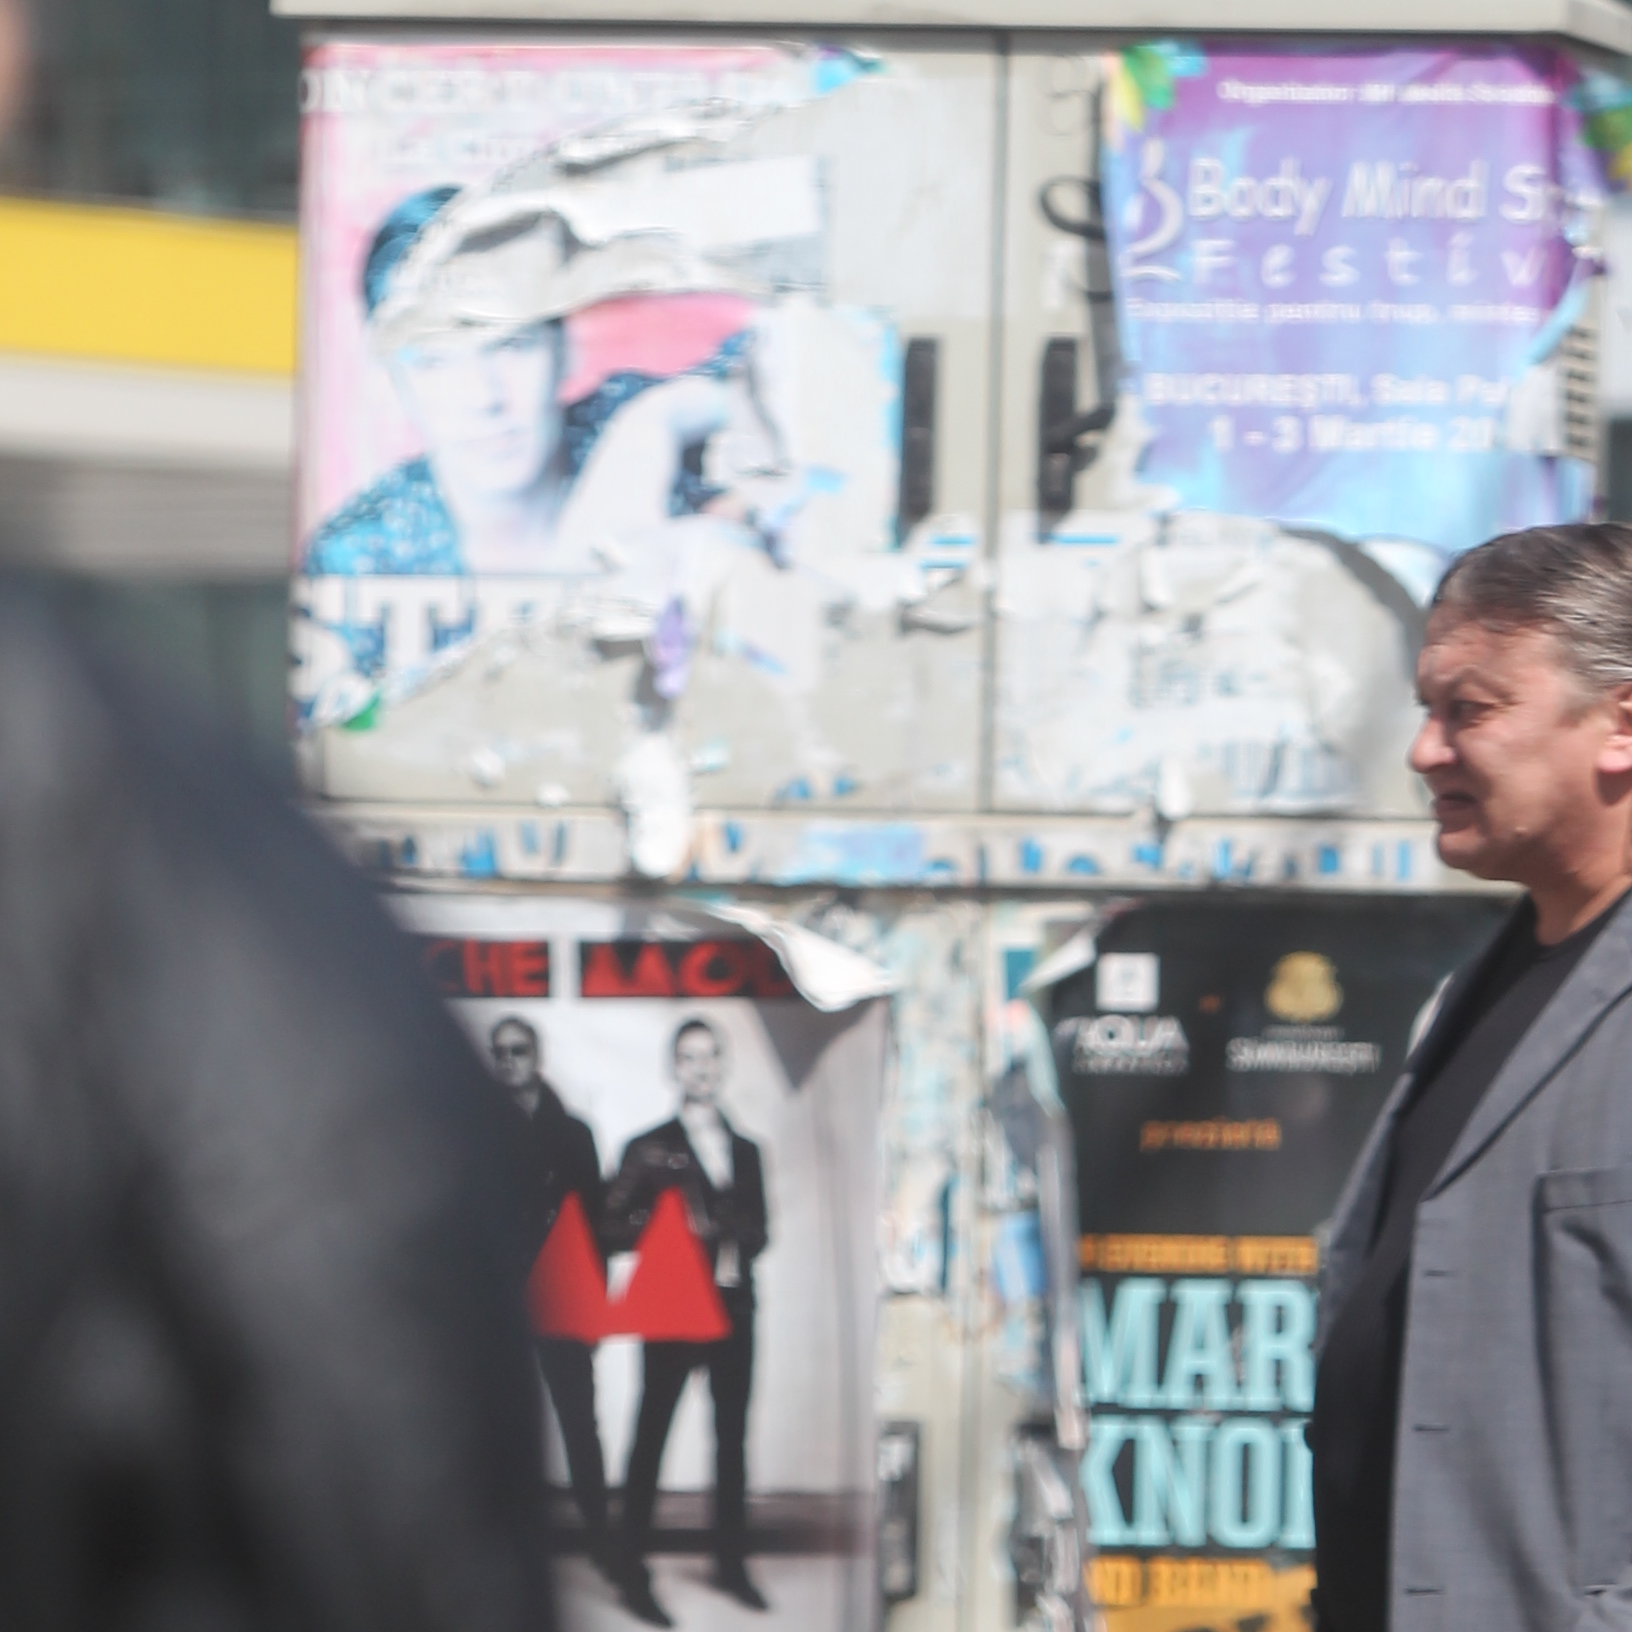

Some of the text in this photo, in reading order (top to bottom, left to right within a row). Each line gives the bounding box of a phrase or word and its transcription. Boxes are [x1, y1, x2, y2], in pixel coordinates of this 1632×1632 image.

[1188, 158, 1328, 234] Body
[1342, 158, 1486, 220] Mind
[1210, 416, 1234, 450] 1
[1274, 416, 1299, 450] 3
[1308, 414, 1438, 449] Martie
